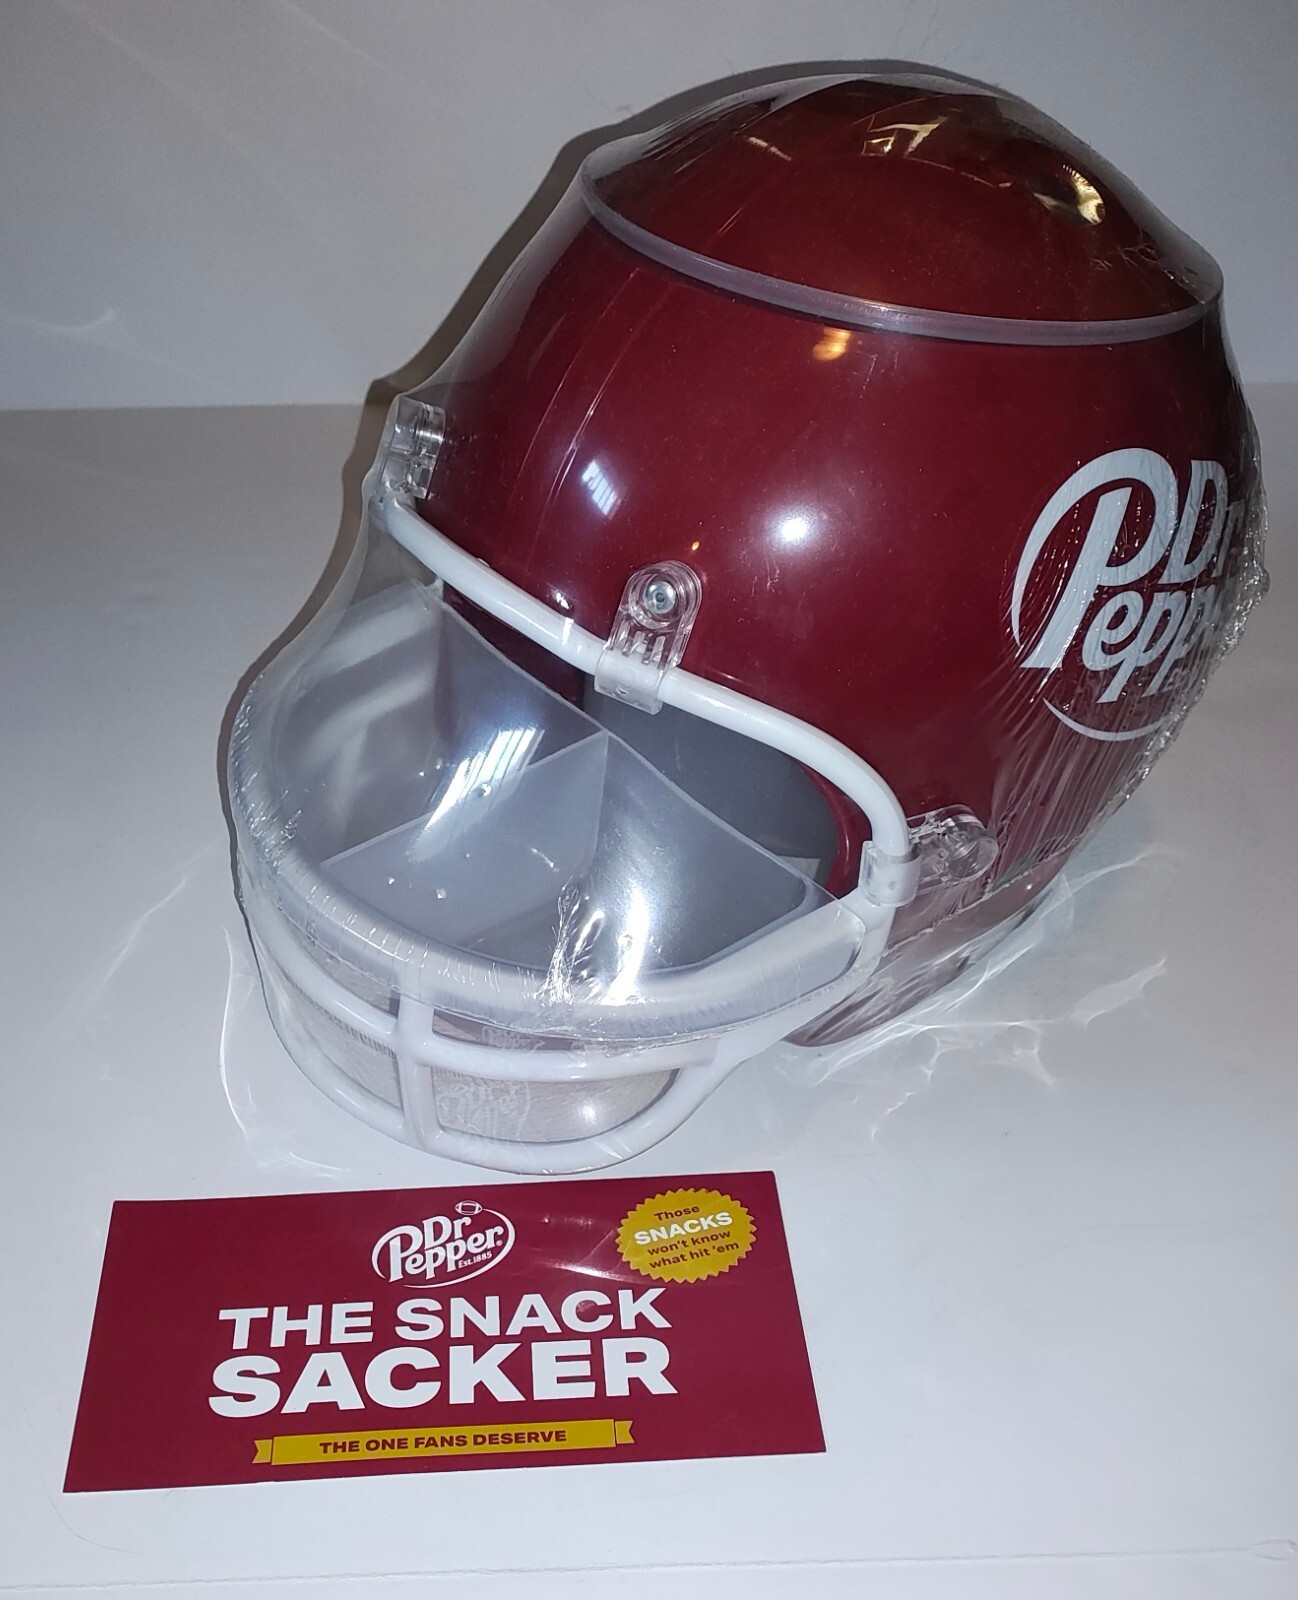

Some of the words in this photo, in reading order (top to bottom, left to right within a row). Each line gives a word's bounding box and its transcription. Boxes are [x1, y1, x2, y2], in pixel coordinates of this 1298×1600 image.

[1011, 447, 1226, 703] Pepp
[634, 1211, 733, 1245] SNACKS
[654, 1205, 701, 1221] Those
[421, 1215, 472, 1250] Dr
[647, 1240, 689, 1256] won't
[690, 1230, 731, 1247] know
[371, 1224, 505, 1283] Pepper
[649, 1253, 688, 1269] what
[689, 1248, 711, 1260] hit
[712, 1242, 740, 1253] 'em
[218, 1301, 374, 1350] THE
[394, 1287, 673, 1341] SNACK
[208, 1336, 679, 1418] SACKER
[319, 1440, 361, 1454] THE
[365, 1437, 409, 1451] ONE
[413, 1434, 468, 1449] FANS
[472, 1429, 567, 1446] DESERVE
